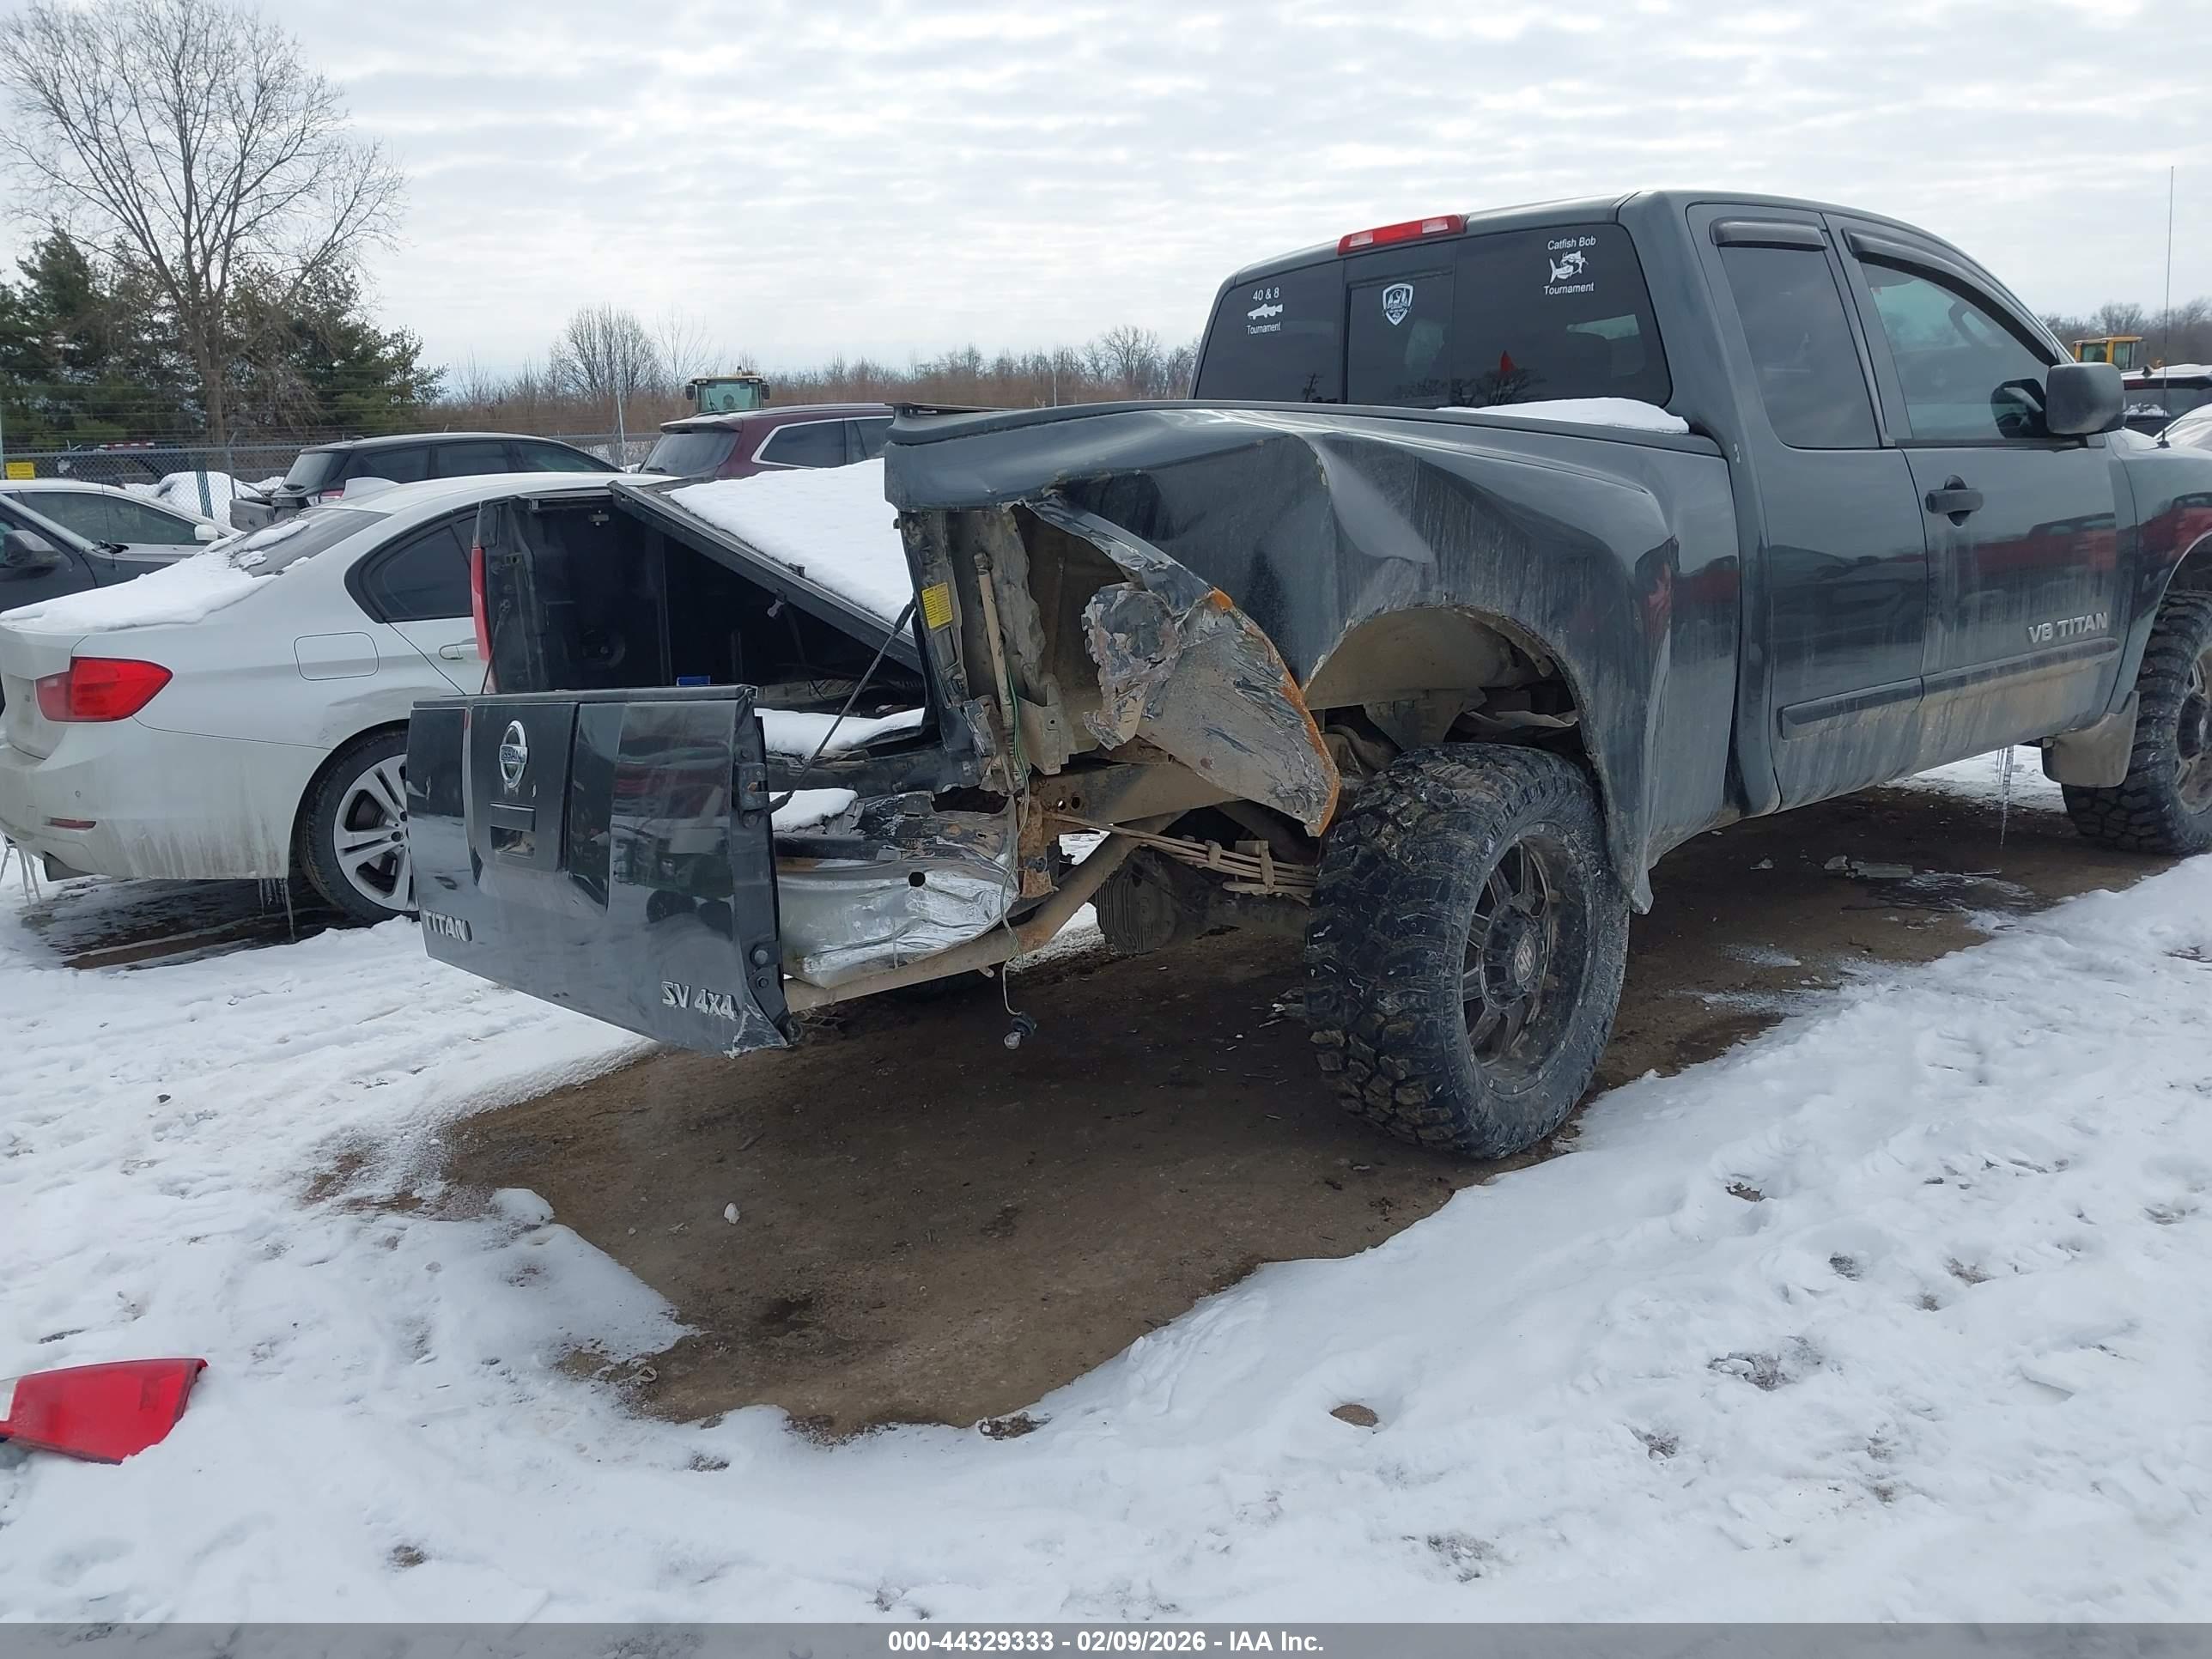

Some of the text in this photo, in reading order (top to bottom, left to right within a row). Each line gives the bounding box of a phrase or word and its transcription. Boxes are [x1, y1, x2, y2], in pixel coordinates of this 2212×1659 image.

[1547, 235, 1596, 250] Catfish Bob
[1252, 286, 1280, 301] 40 & 8
[1543, 282, 1594, 295] Tournament
[1246, 321, 1281, 336] Tournament
[2028, 612, 2107, 643] V8 TITAN
[422, 910, 470, 942] TITAN
[661, 980, 691, 1008] SV
